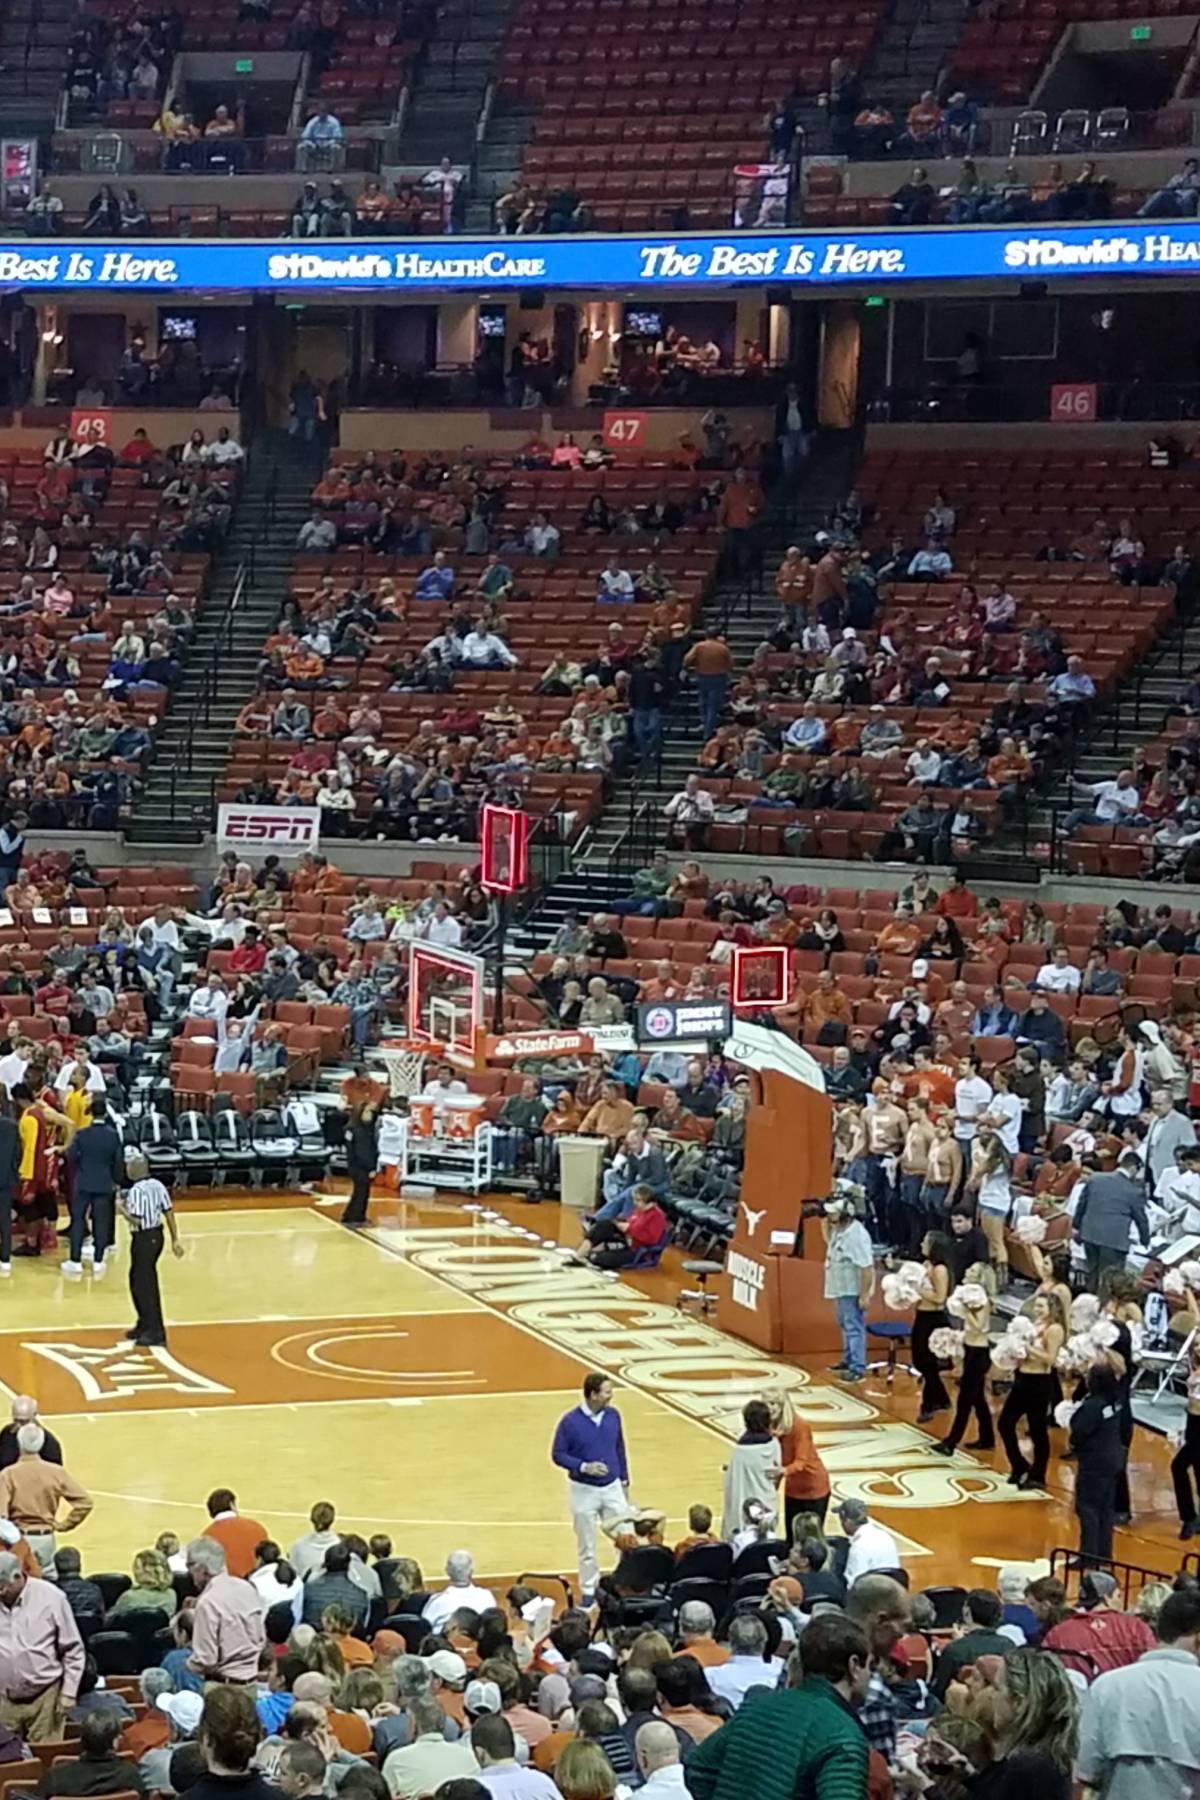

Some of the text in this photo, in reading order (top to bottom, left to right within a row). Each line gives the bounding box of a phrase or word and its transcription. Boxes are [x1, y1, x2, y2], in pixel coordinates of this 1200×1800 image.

[63, 252, 94, 280] Is
[98, 252, 179, 282] Here.
[640, 243, 905, 277] The Best Is Here.
[1057, 391, 1090, 414] 46
[609, 419, 641, 441] 47
[225, 815, 313, 840] ESPN
